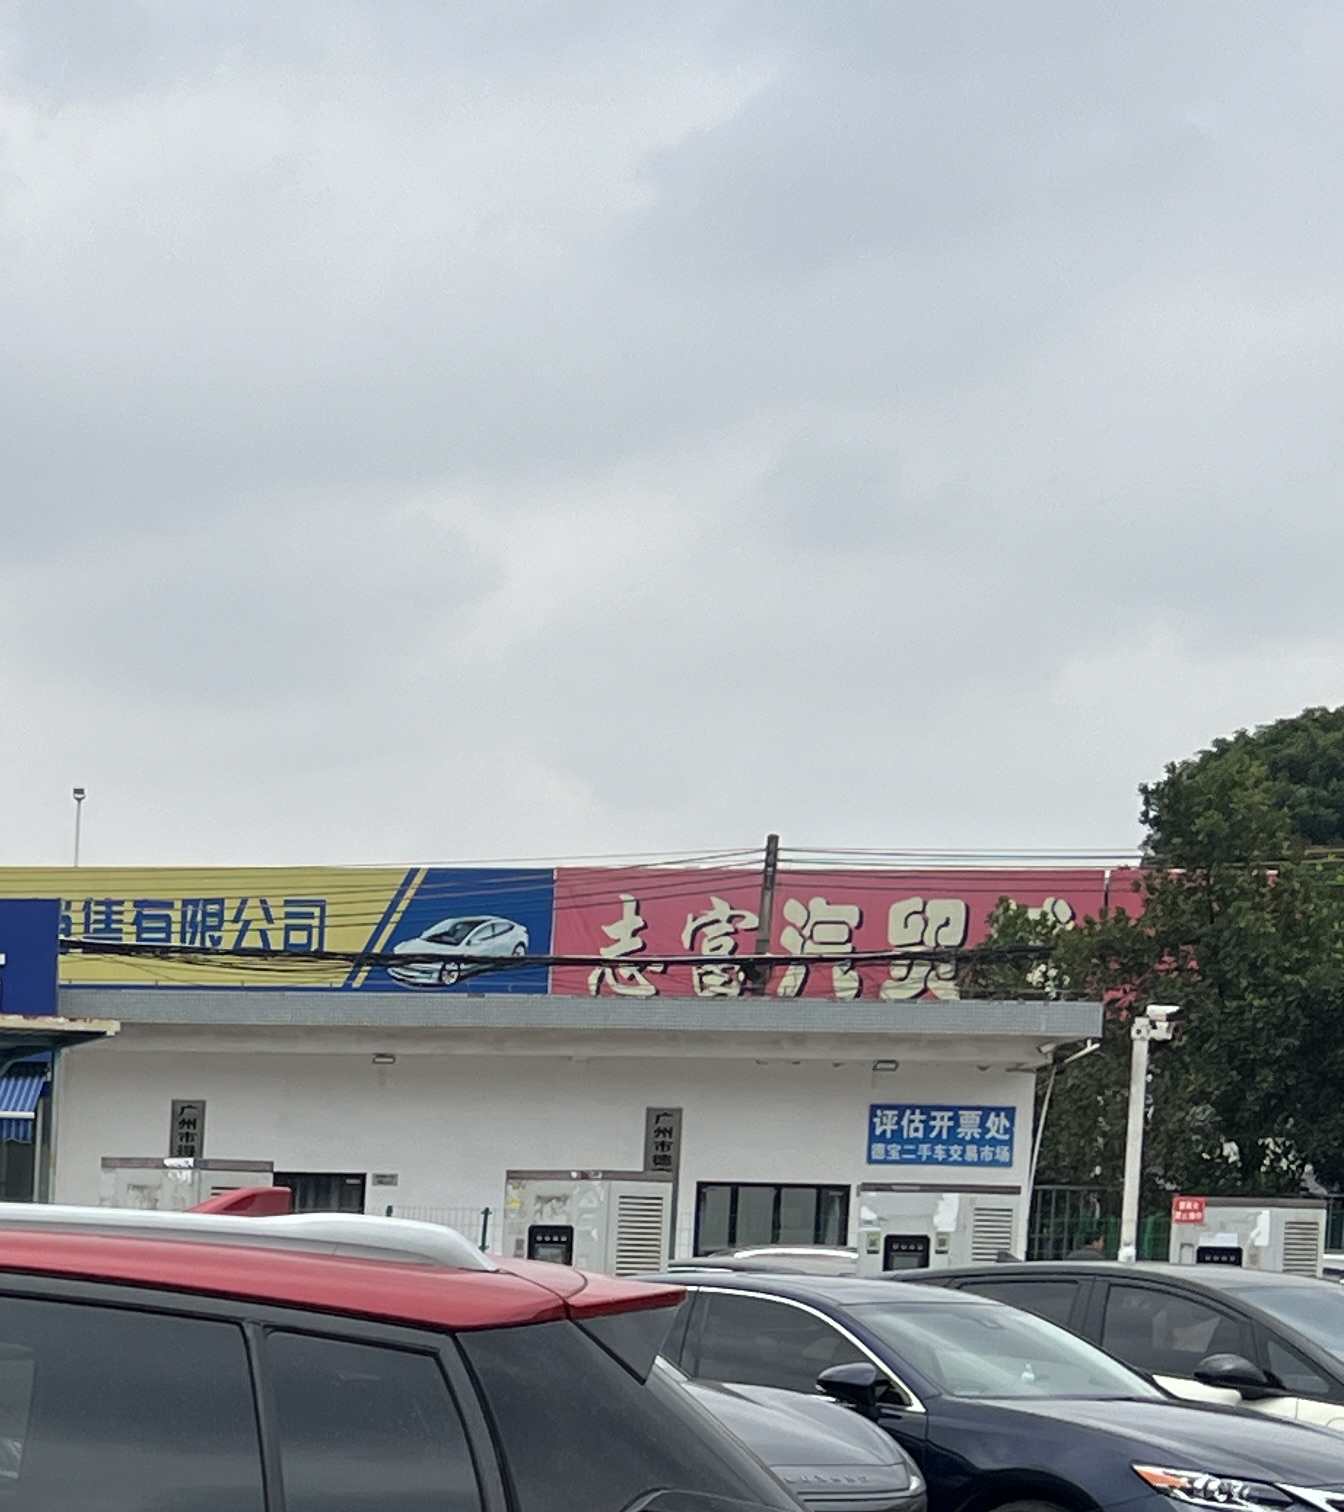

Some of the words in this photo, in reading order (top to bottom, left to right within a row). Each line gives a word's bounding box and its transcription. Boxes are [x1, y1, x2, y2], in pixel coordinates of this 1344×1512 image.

[587, 893, 1078, 1000] 志富汽贸
[873, 1109, 1010, 1140] 评估开票处
[871, 1143, 1010, 1162] 德宝二手车交易市场
